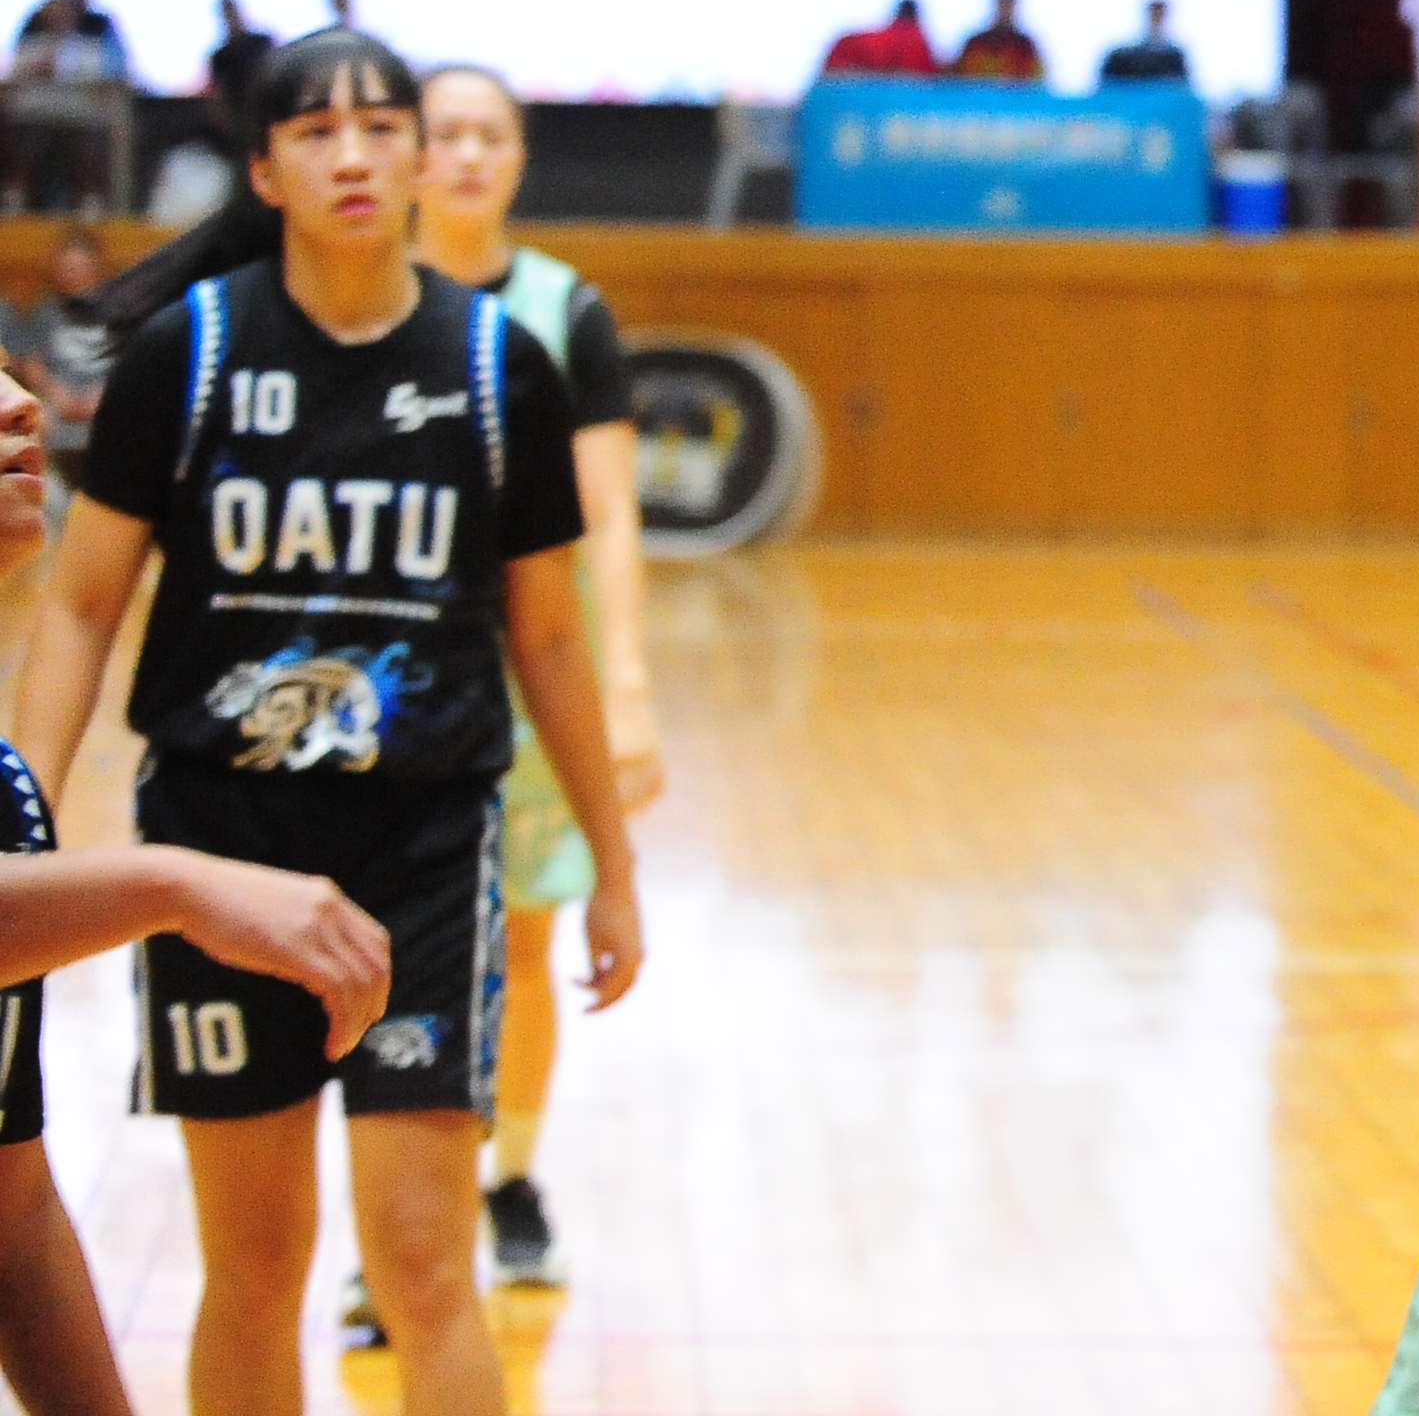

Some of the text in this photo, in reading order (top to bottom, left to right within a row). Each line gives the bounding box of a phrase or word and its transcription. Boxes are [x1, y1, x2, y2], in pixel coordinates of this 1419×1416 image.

[231, 368, 297, 434] 10
[212, 477, 458, 580] OATU
[167, 1001, 248, 1076] 10
